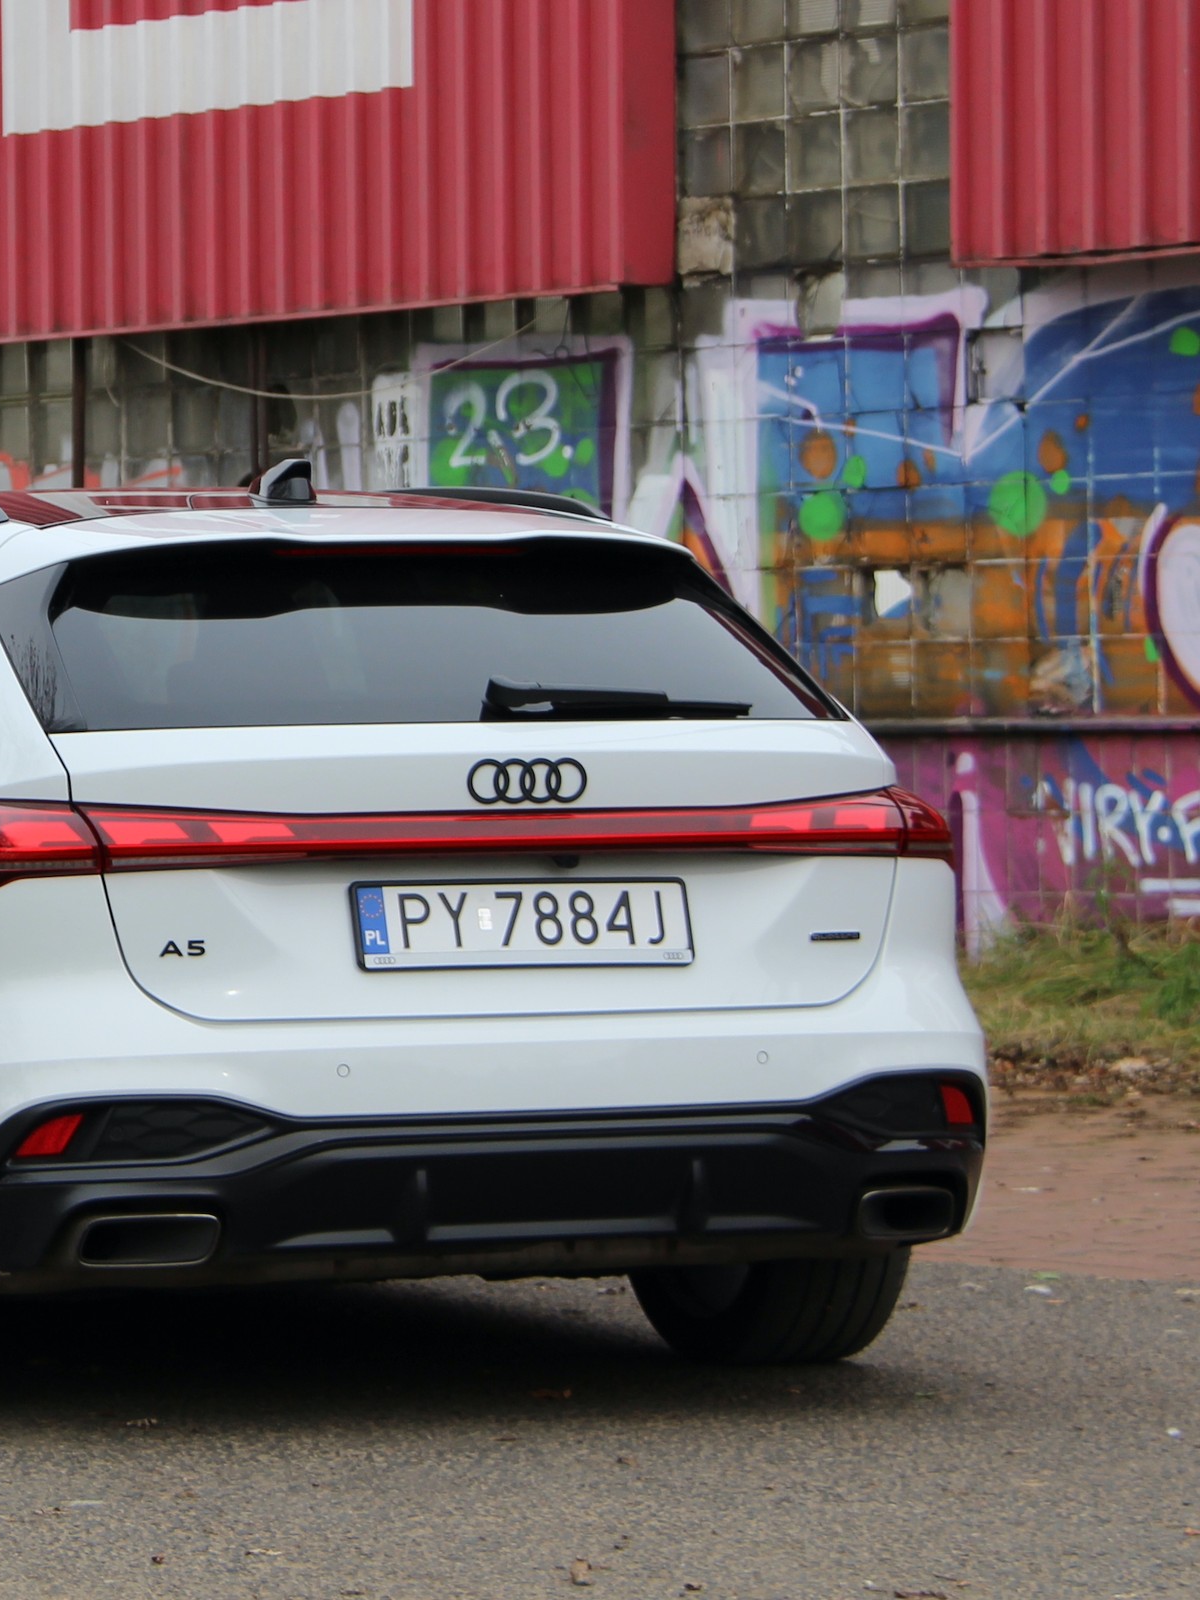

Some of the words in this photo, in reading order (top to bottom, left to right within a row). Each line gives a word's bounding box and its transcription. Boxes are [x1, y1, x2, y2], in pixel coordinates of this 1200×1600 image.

[397, 891, 468, 950] PY
[494, 889, 666, 948] 7884J
[364, 929, 386, 947] PL
[159, 940, 206, 958] A5
